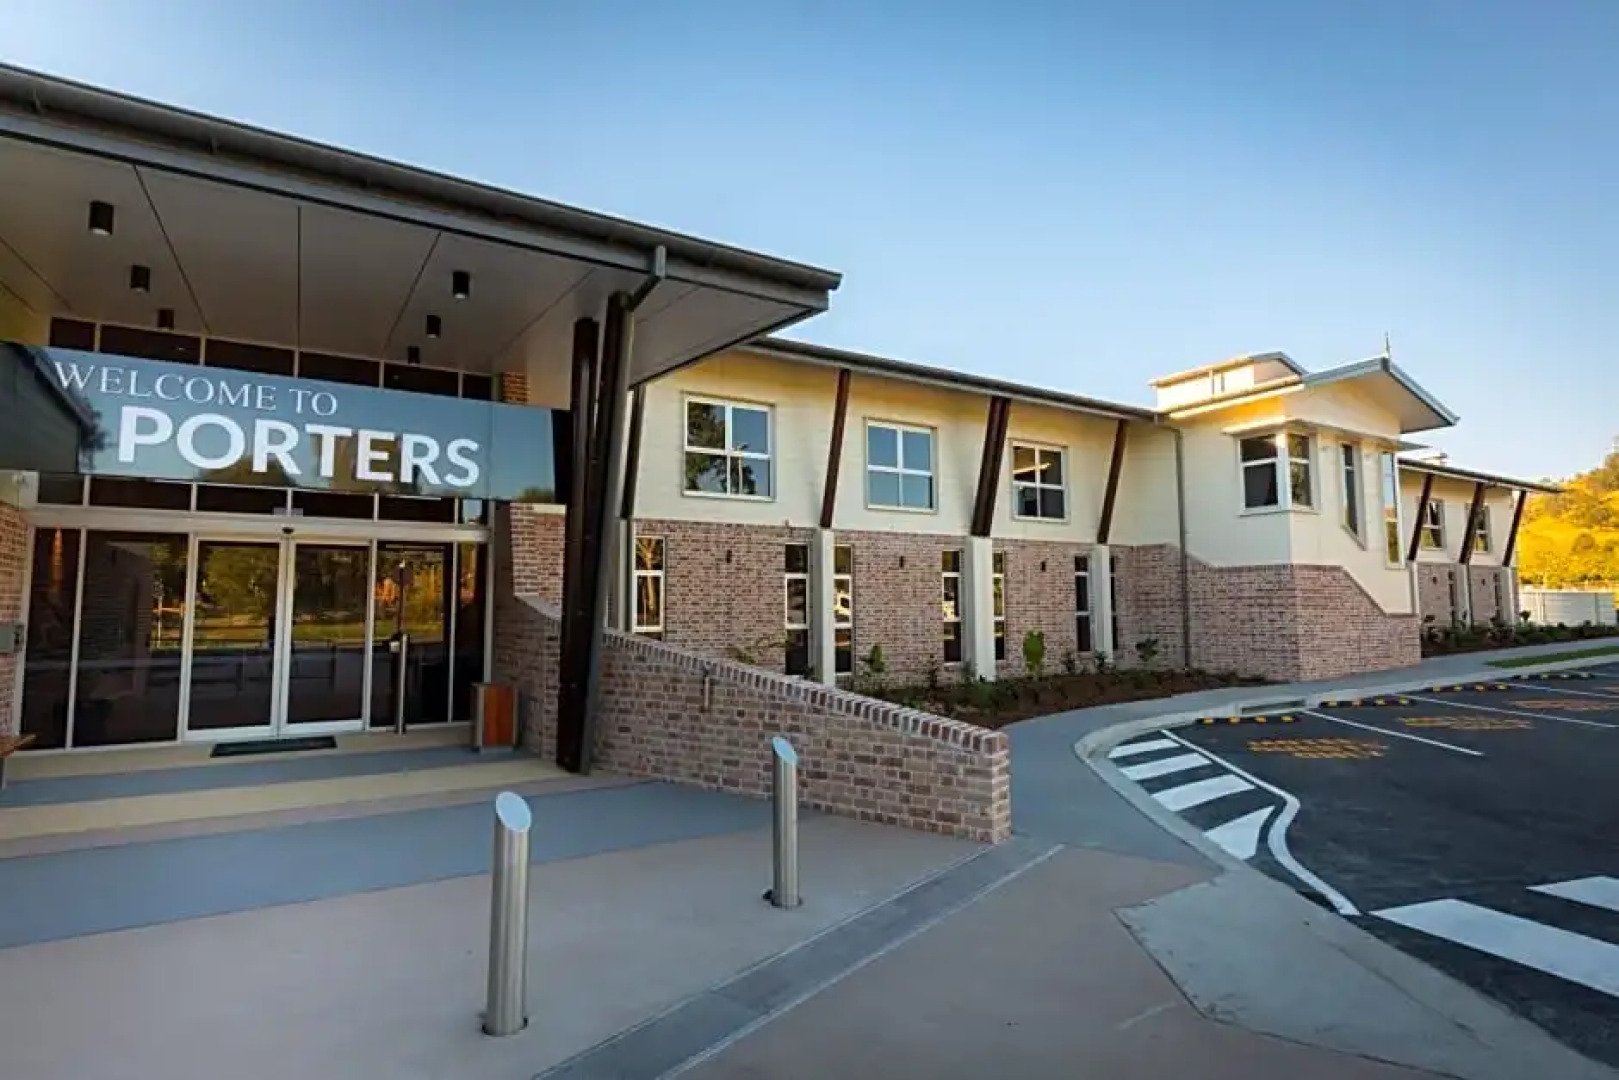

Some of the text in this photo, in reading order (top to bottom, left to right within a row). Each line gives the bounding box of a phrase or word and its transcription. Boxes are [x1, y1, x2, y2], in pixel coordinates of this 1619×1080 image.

[54, 361, 338, 416] WELCOME TO
[117, 405, 480, 487] PORTERS
